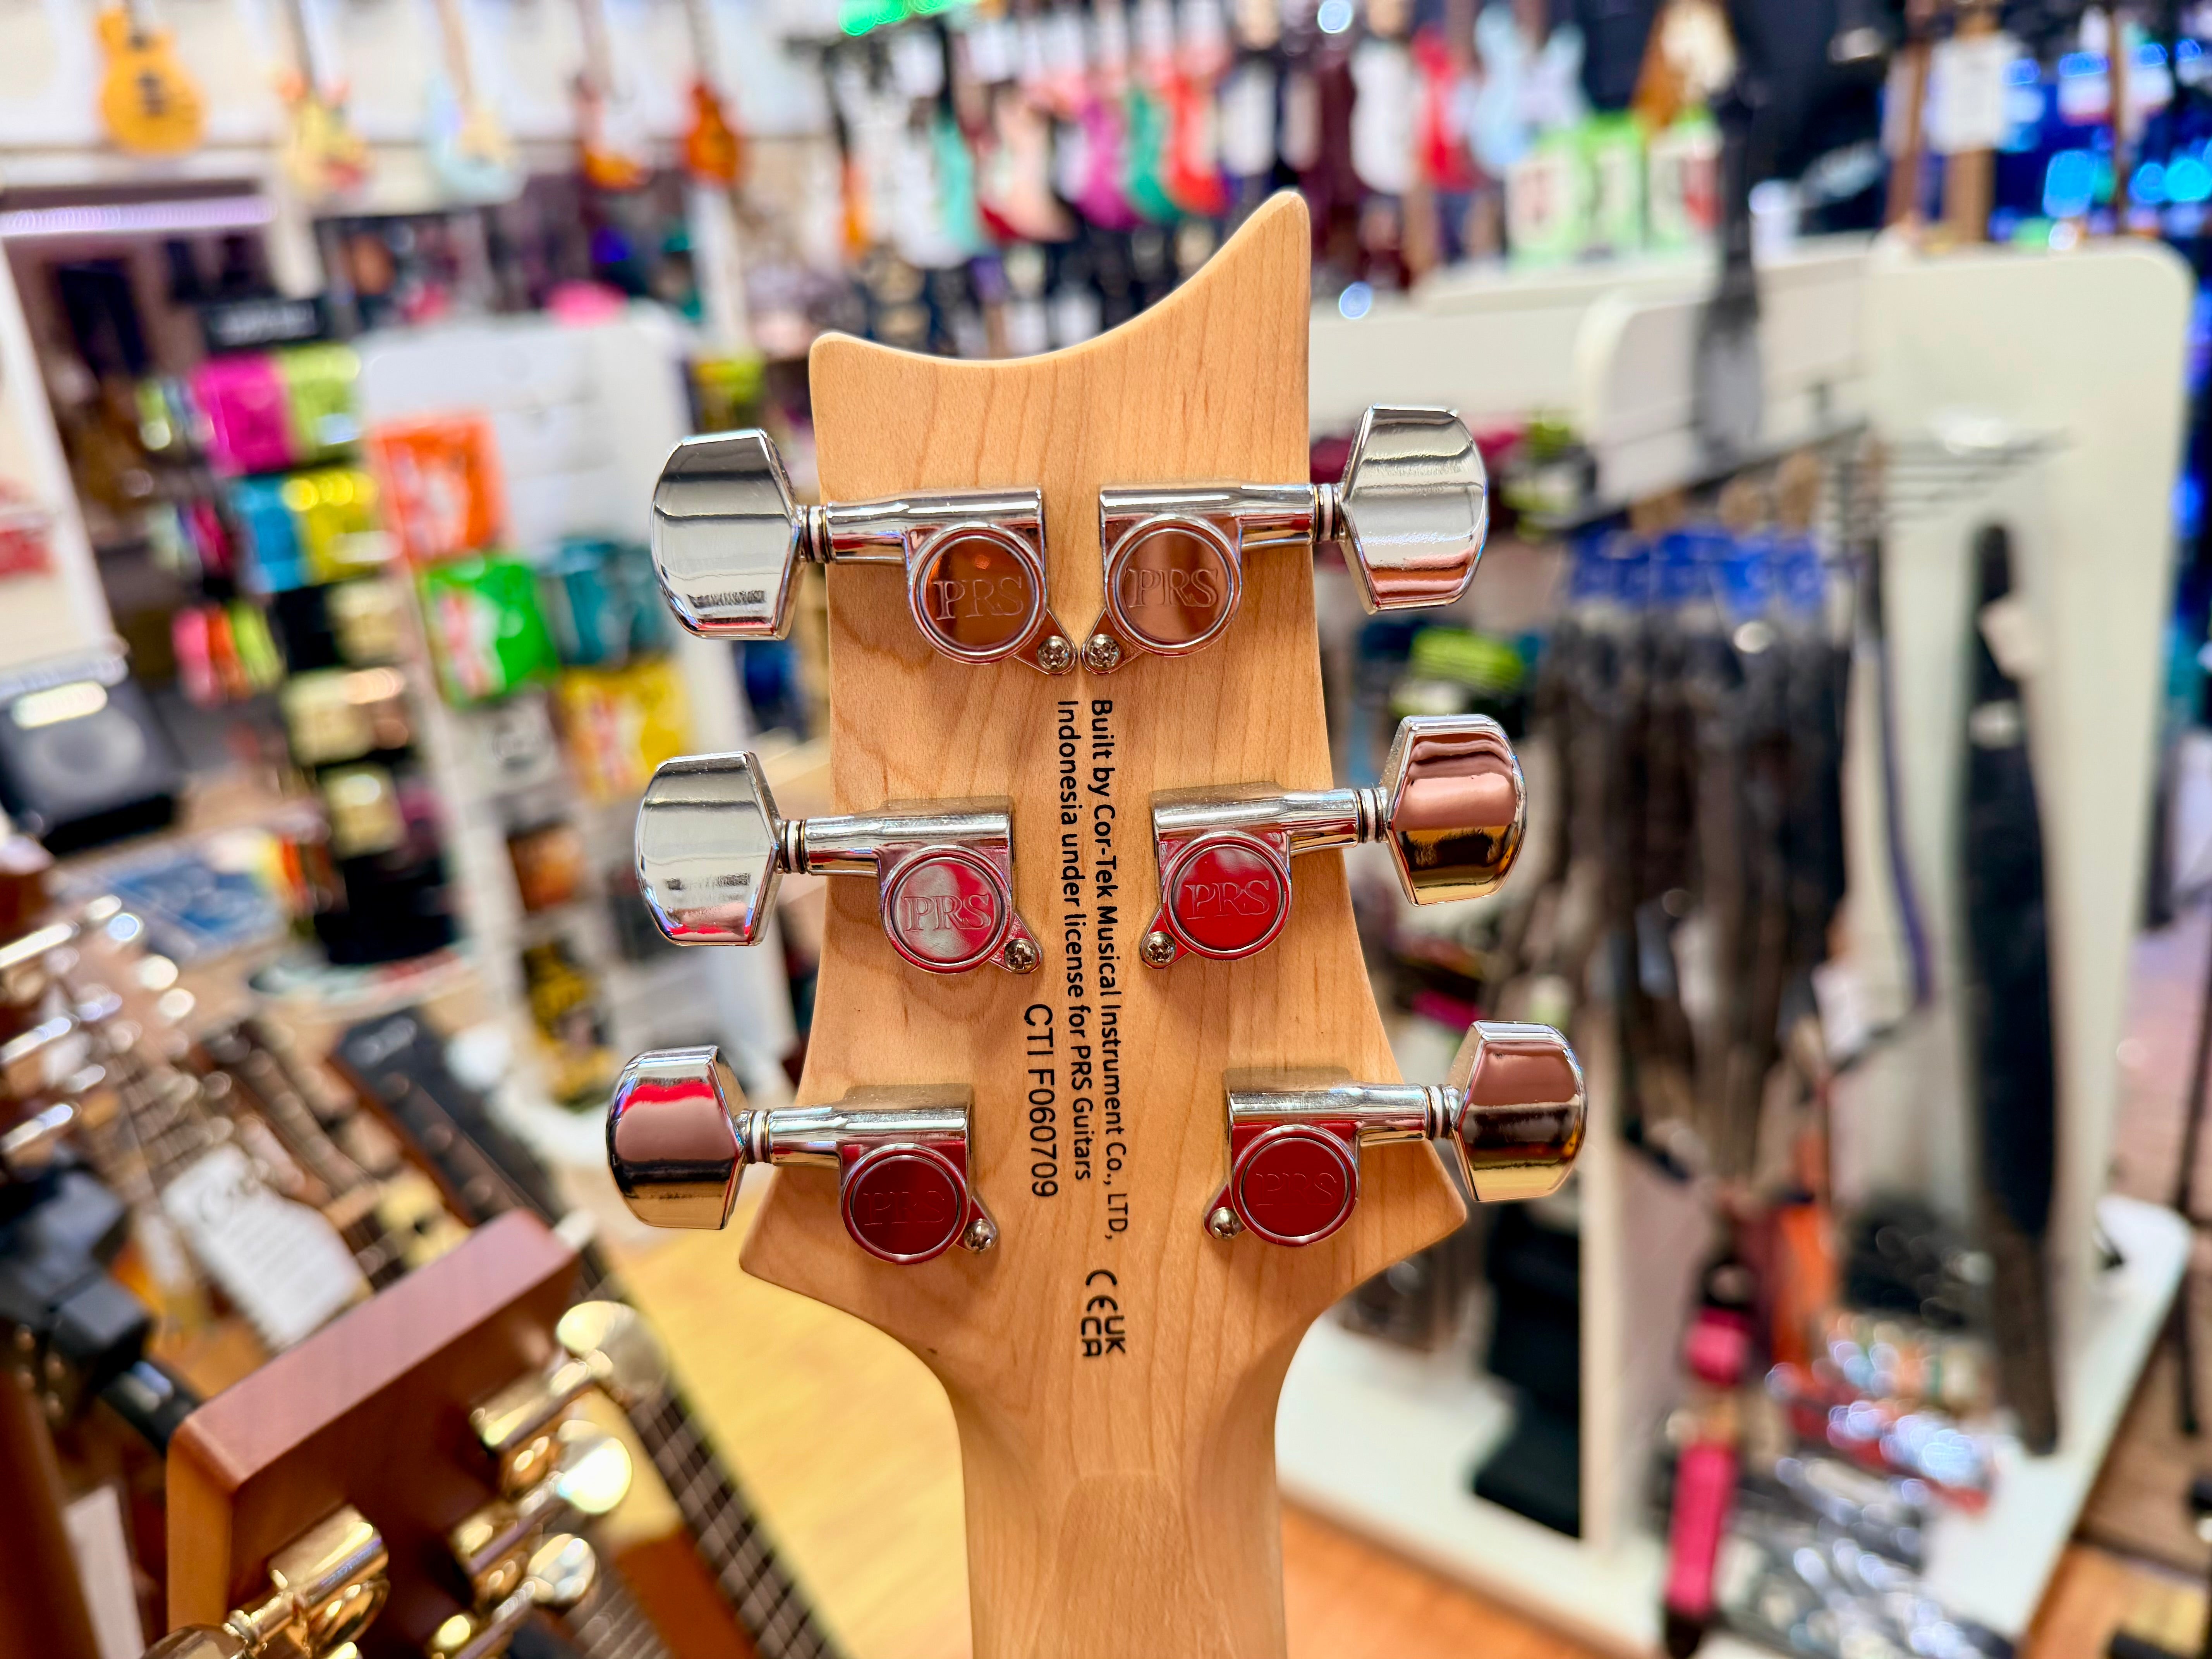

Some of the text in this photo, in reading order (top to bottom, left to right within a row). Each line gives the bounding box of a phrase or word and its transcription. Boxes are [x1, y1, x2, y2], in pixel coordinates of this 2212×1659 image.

[933, 577, 1024, 620] PRS
[1125, 567, 1219, 608] PRS
[902, 893, 992, 932] PRS
[1184, 879, 1270, 920] PRS
[1057, 701, 1095, 1181] Indonesia under license for PRS Guitars
[1087, 699, 1128, 1240] Built by Cor-Tek Musical Instrument Co., LTD,
[1024, 1003, 1059, 1197] CTI F060709
[1255, 1172, 1337, 1206] PRS
[1080, 1316, 1103, 1357] CA
[1104, 1315, 1126, 1354] UK
